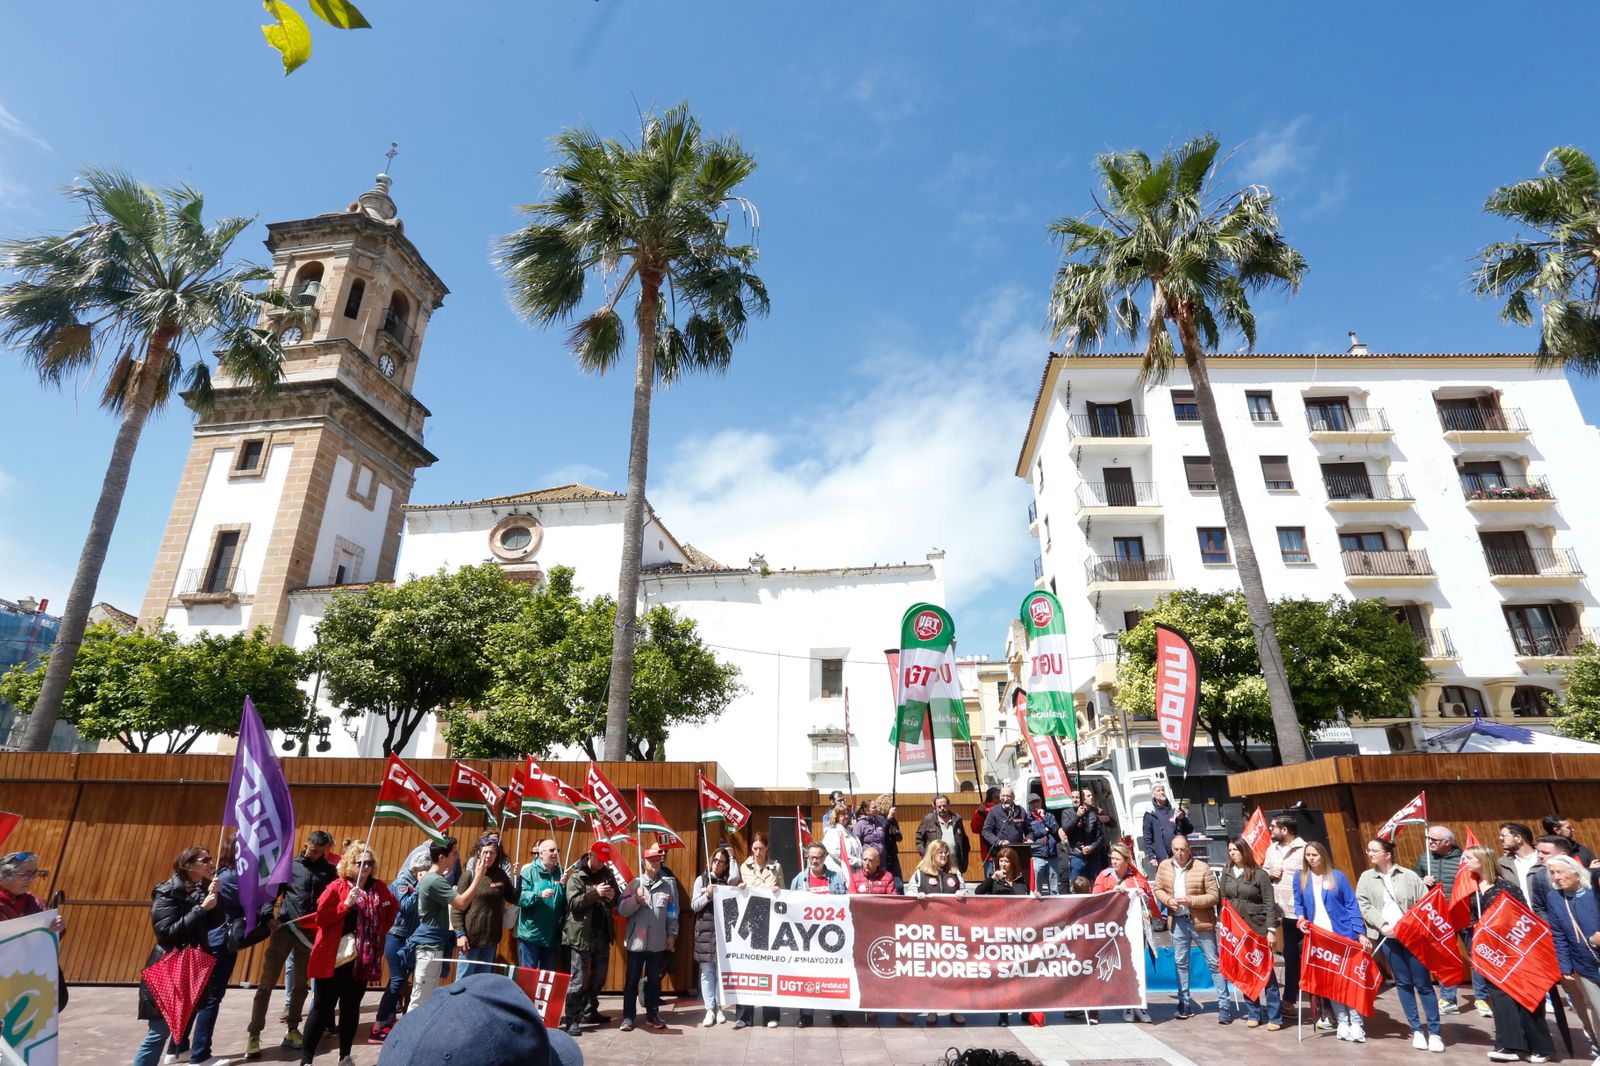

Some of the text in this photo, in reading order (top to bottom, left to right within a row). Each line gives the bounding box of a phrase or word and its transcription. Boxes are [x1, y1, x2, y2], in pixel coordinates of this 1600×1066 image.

[803, 906, 846, 921] 2024
[1421, 902, 1450, 933] PSOE
[895, 921, 1124, 943] POR EL PLENO EMPLEO:
[725, 952, 786, 963] #PLENOEMPLEO
[793, 957, 844, 965] #1MAYO2024
[895, 942, 1076, 961] MENOS JORNADA,
[1311, 945, 1342, 966] PSOE
[895, 959, 1094, 979] MEJORES SALARIOS
[780, 980, 803, 992] UGT
